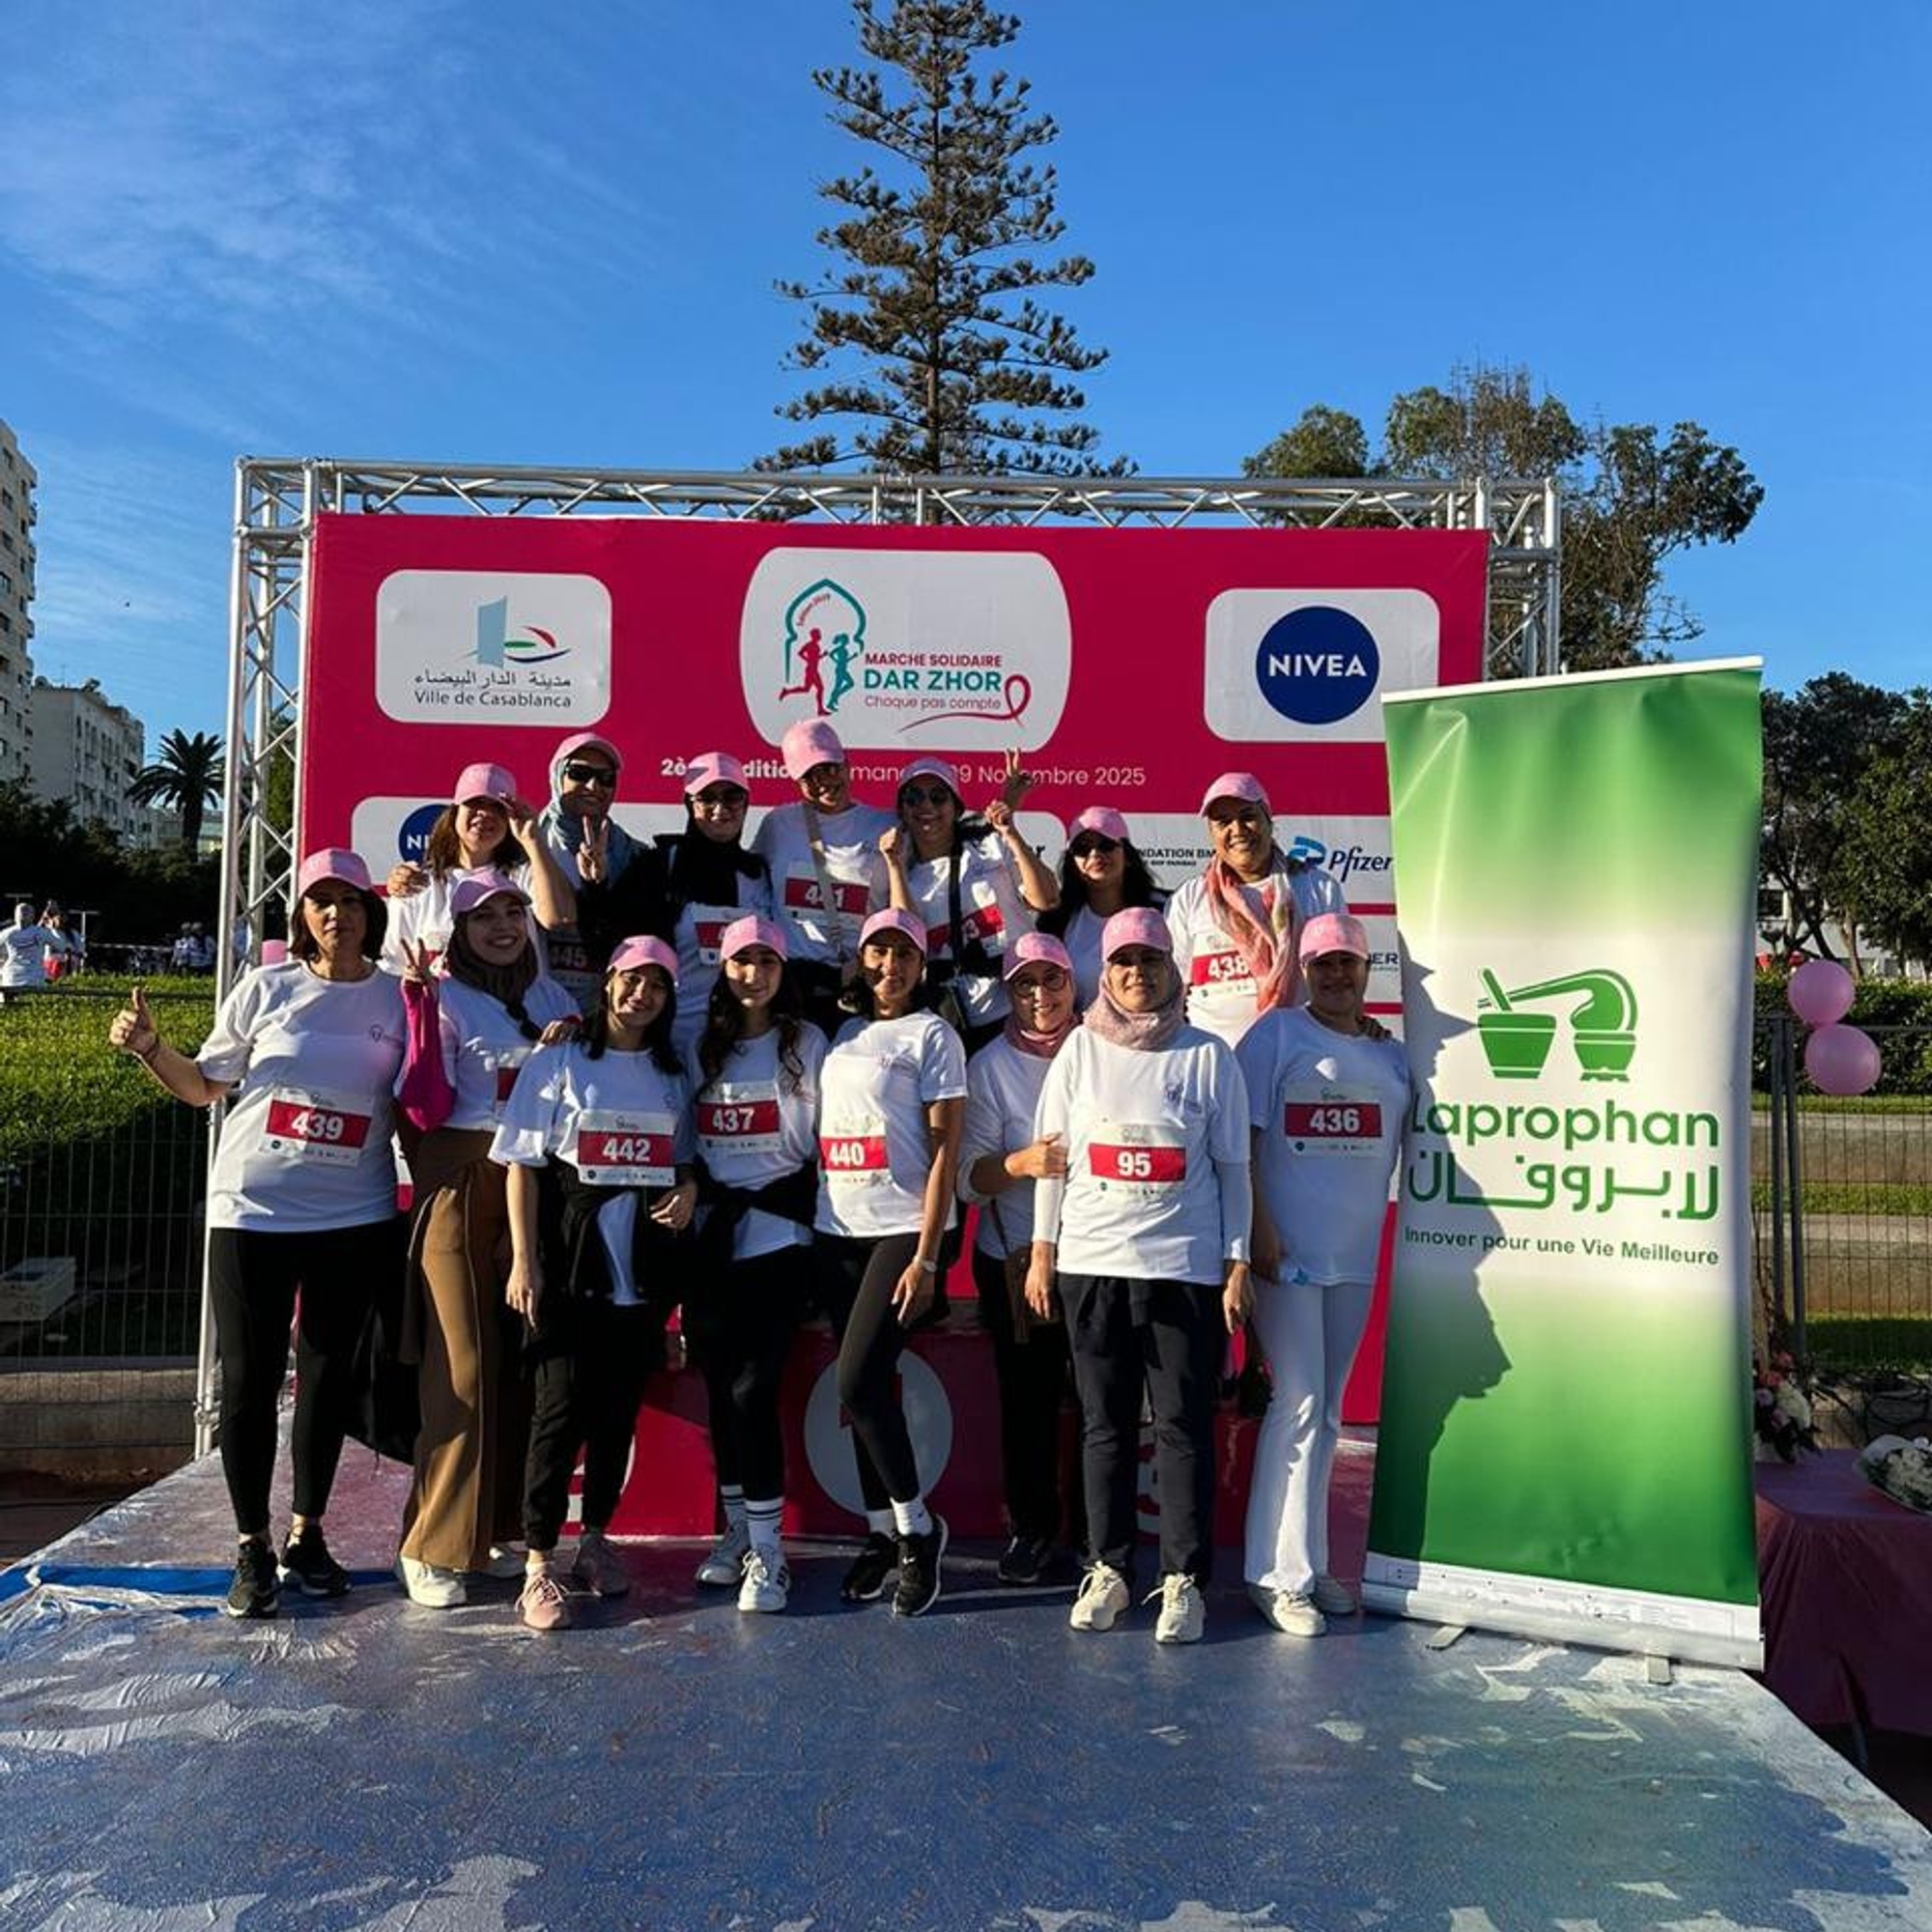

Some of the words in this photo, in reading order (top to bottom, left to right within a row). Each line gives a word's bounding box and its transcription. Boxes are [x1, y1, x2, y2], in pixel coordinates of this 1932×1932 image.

[865, 653, 926, 667] MARCHE
[930, 654, 1002, 668] SOLIDAIRE
[1268, 654, 1368, 677] NIVEA
[414, 668, 477, 688] البيضاء
[477, 670, 517, 690] الدار
[528, 671, 572, 690] مدينة
[865, 669, 920, 689] DAR
[927, 670, 1002, 692] ZHOR
[414, 691, 450, 705] Ville
[454, 692, 474, 705] de
[479, 692, 572, 707] Casablanca
[865, 696, 918, 710] Chaque
[921, 697, 947, 711] pas
[950, 697, 1002, 711] compte
[742, 759, 789, 778] ditio
[978, 766, 1089, 785] Nombre
[1094, 767, 1147, 785] 2025
[1138, 848, 1194, 858] NDATION
[1328, 846, 1394, 883] Pfizer
[805, 885, 844, 907] 41
[1208, 955, 1249, 979] 438
[291, 1111, 344, 1140] 439
[712, 1107, 755, 1132] 437
[1310, 1108, 1360, 1132] 436
[1410, 1094, 1719, 1151] Laprophan
[602, 1138, 651, 1162] 442
[829, 1142, 865, 1166] 440
[1117, 1151, 1152, 1177] 95
[1405, 1225, 1478, 1247] Innover
[1483, 1232, 1532, 1252] pour
[1537, 1236, 1576, 1254] une
[1582, 1237, 1614, 1257] Vie
[1621, 1241, 1719, 1265] Meilleure
